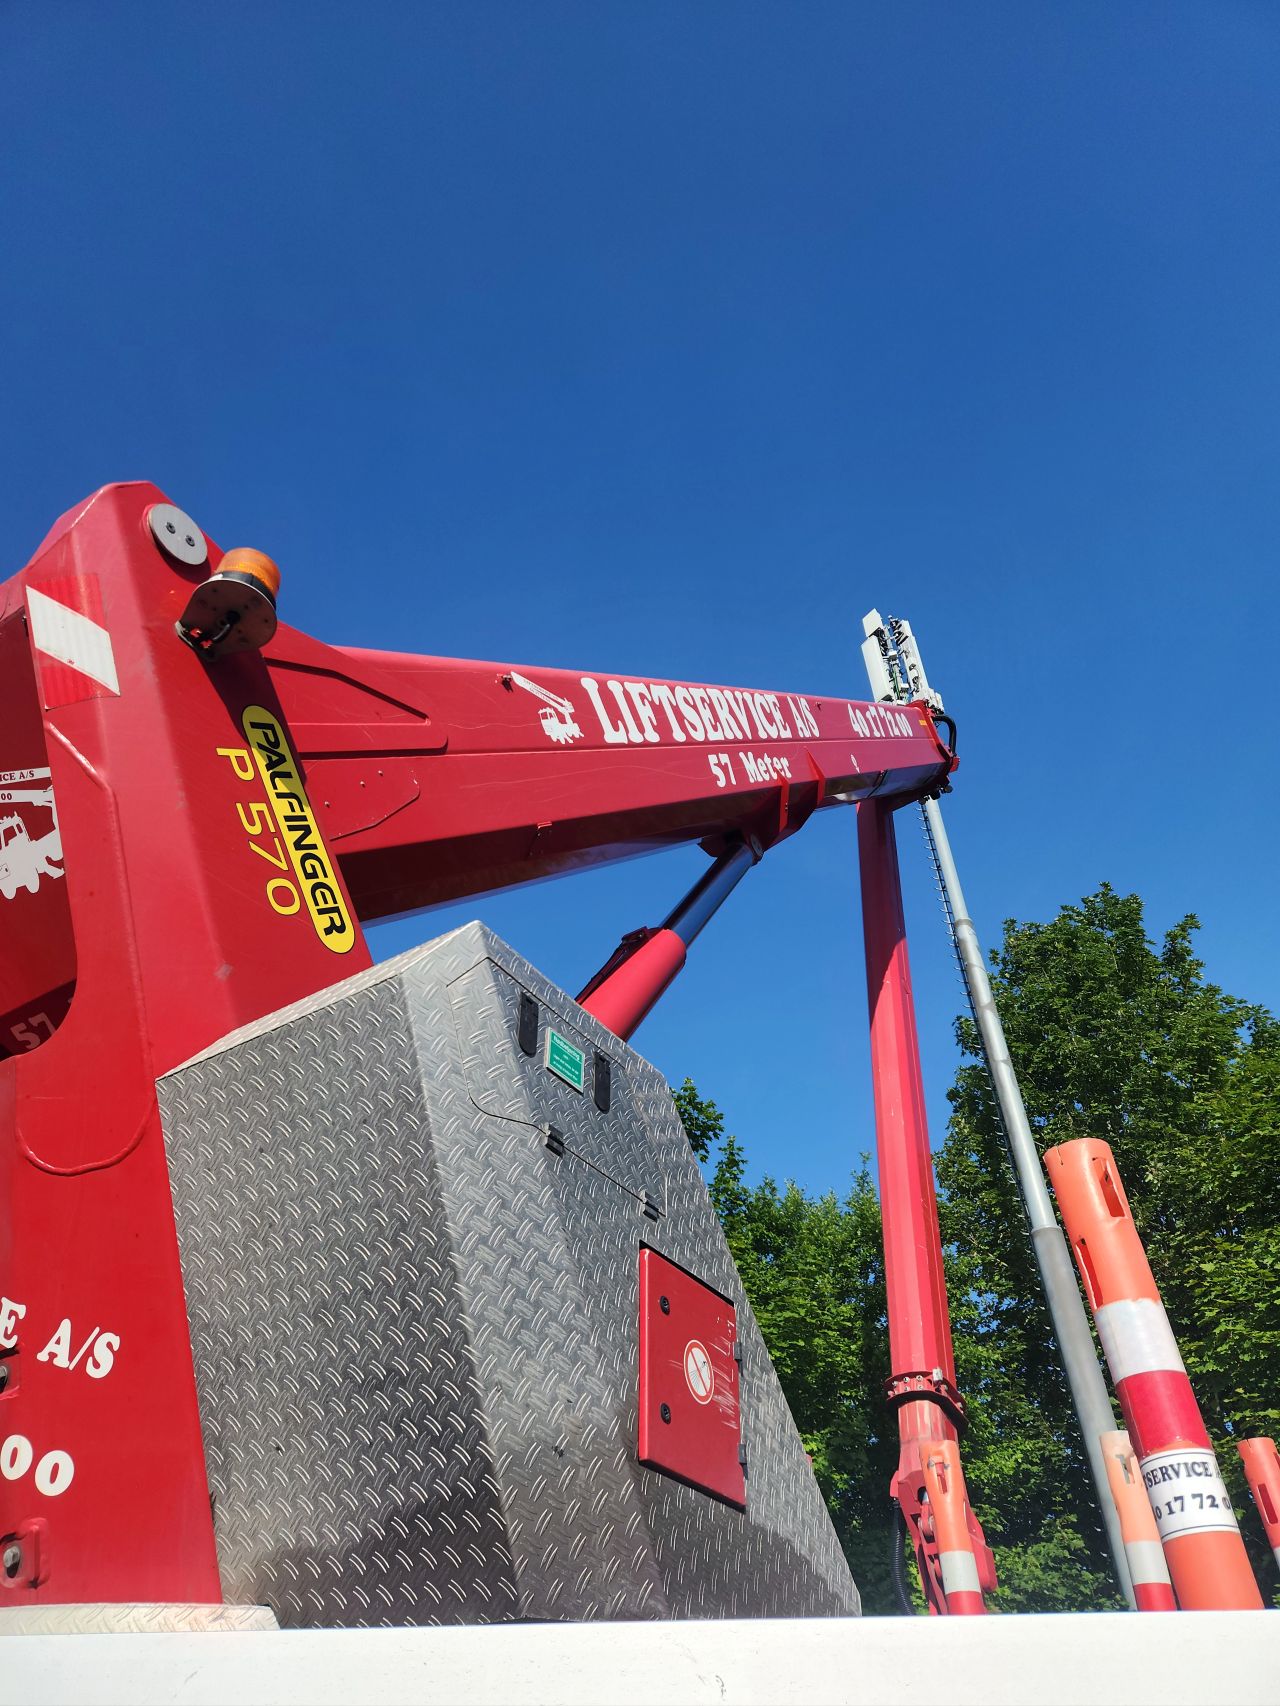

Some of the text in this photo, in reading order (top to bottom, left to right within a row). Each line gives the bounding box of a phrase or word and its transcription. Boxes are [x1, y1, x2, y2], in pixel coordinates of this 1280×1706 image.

[580, 677, 792, 744] LIFTSERVICE
[787, 695, 820, 738] A/S
[19, 769, 35, 780] A/S
[707, 751, 793, 788] 57 Meter
[215, 747, 302, 917] P 570
[249, 721, 347, 937] PALFINGER
[10, 1011, 56, 1051] 57
[36, 1318, 121, 1379] A/S
[0, 1434, 75, 1497] 00
